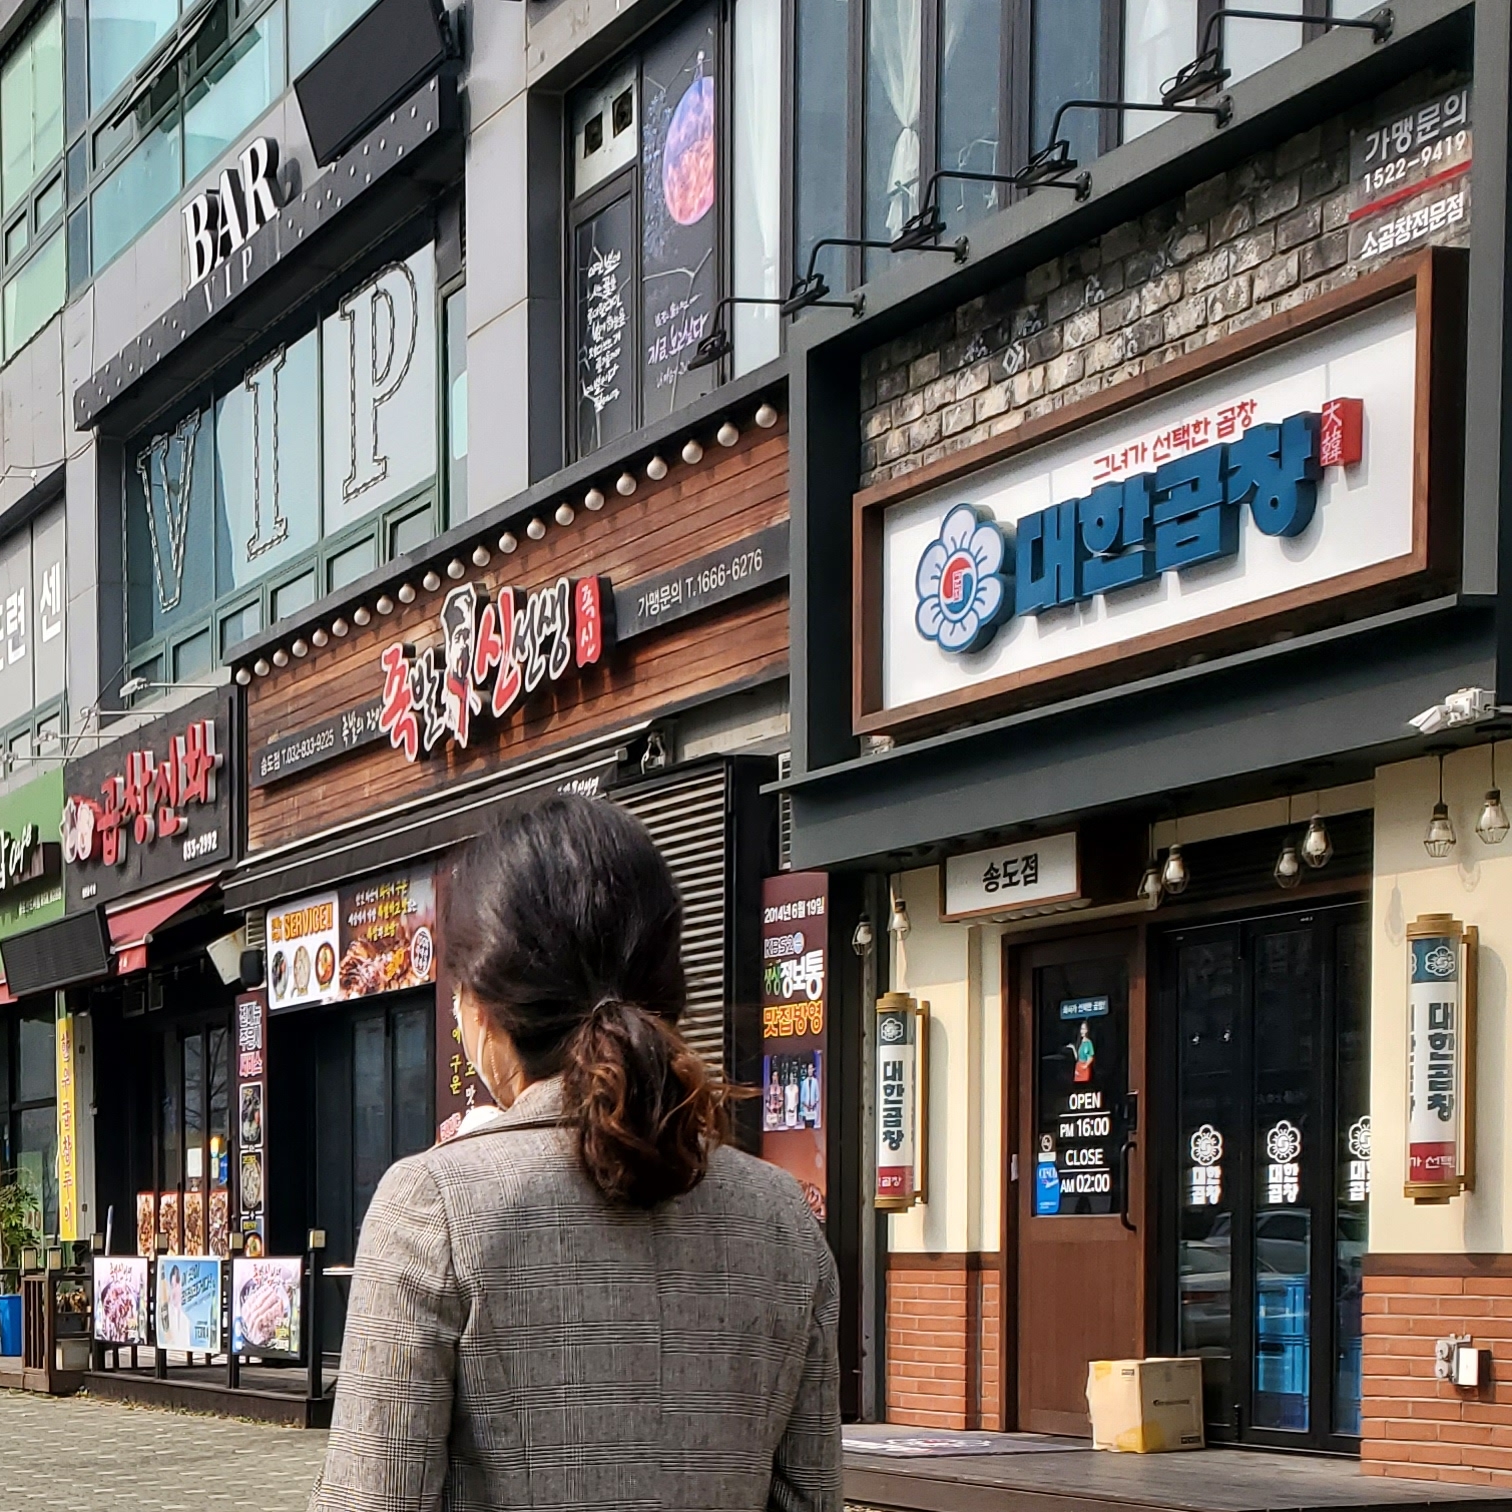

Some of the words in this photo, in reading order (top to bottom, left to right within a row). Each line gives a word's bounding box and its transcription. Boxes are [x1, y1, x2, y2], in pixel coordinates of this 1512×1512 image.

[1364, 90, 1467, 162] 가맹문의
[1364, 130, 1467, 193] 1522-9419
[180, 136, 280, 292] BAR
[1360, 191, 1465, 260] 소곱창전문점
[202, 243, 254, 314] VIP
[136, 259, 418, 613] VIP
[1093, 442, 1149, 480] 그녀가
[1152, 416, 1212, 463] 선택한
[1215, 399, 1258, 440] 곱창
[1321, 400, 1344, 467] 大韓
[1015, 410, 1324, 617] 대한곱창
[637, 579, 683, 617] 가맹문의
[685, 548, 763, 598] T.1666-6276
[379, 642, 446, 762] 족발
[474, 576, 571, 718] 신선생
[260, 750, 281, 777] 송도점
[97, 719, 216, 867] 곱창신화
[982, 852, 1039, 893] 송도점
[764, 903, 792, 924] 2014년
[791, 899, 807, 920] 6월
[806, 896, 825, 917] 19일
[764, 935, 794, 959] KBS2
[763, 1001, 824, 1039] 맛집방영
[1428, 1002, 1455, 1122] 대한곱창
[882, 1060, 905, 1151] 대한곱창
[1059, 1123, 1075, 1138] PM
[1075, 1117, 1110, 1138] 16:00
[1068, 1092, 1102, 1111] OPEN
[1060, 1179, 1075, 1193] AM
[1076, 1174, 1110, 1193] 02:00
[1065, 1149, 1104, 1166] CLOSE
[1192, 1166, 1221, 1184] 대한
[1268, 1163, 1300, 1183] 대한
[1191, 1184, 1221, 1205] 곱창
[1268, 1182, 1300, 1204] 곱창
[1349, 1180, 1371, 1202] 곱
